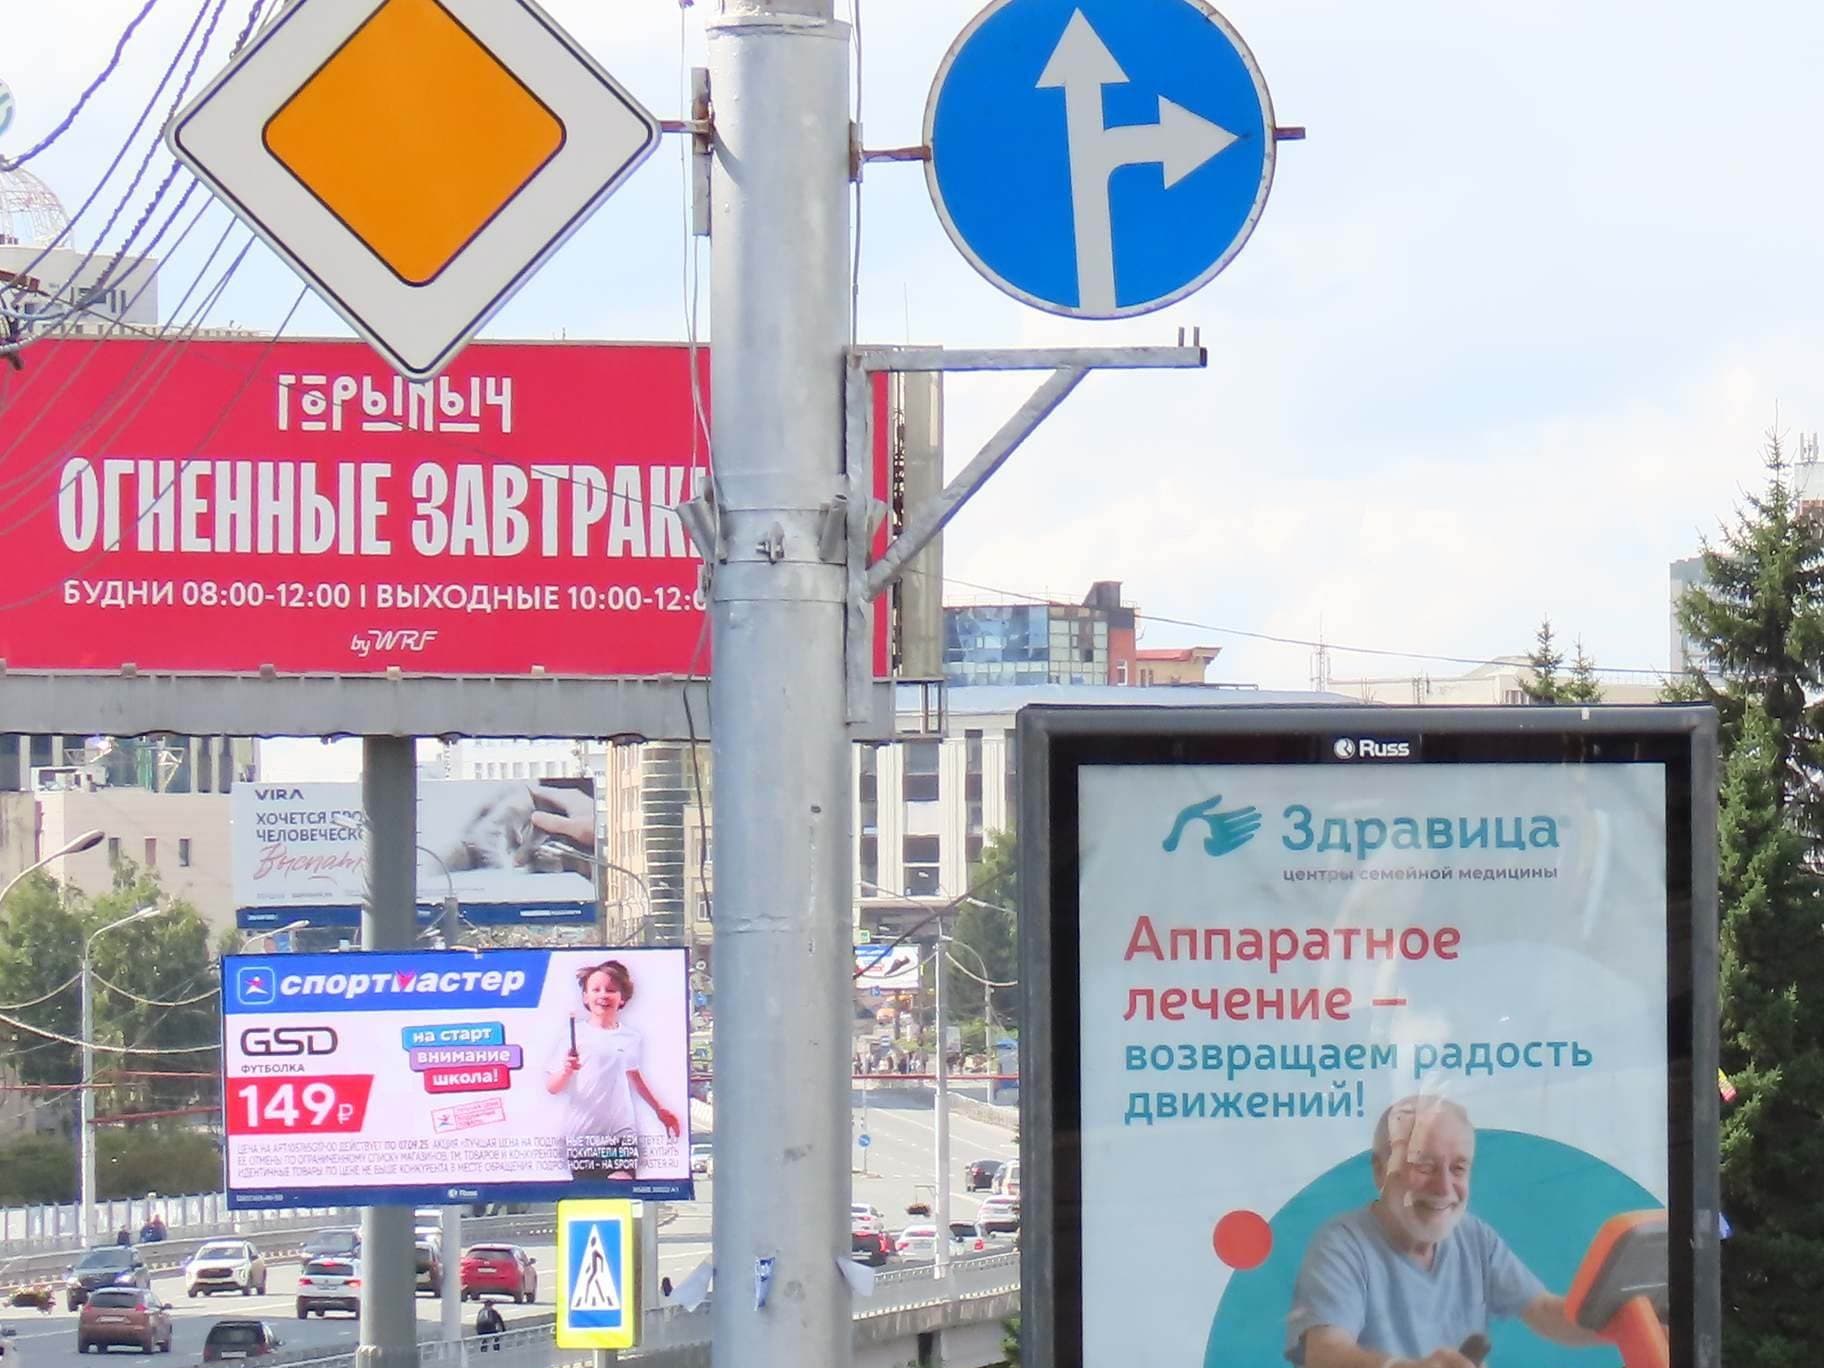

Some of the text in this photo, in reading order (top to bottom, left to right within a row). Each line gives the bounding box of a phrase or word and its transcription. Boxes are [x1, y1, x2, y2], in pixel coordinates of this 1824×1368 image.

[57, 456, 706, 560] ОГНЕННЫЕ ЗАВТРАК
[63, 579, 174, 608] БУДНИ
[182, 580, 351, 610] 08:00-12:00
[376, 582, 560, 613] ВЫХОДНЫЕ
[1359, 739, 1411, 758] Russ
[256, 811, 327, 825] ХОЧЕТСЯ
[1280, 803, 1561, 861] Здравица
[1282, 866, 1558, 883] центры семейной медицины
[1123, 914, 1462, 973] Аппаратное
[1123, 984, 1353, 1022] лечение
[240, 1026, 338, 1056] GSD
[413, 1027, 492, 1042] на старт
[240, 1063, 305, 1074] ФУТБОЛКА
[416, 1050, 510, 1063] внимание
[1123, 1039, 1593, 1080] возвращаем радость
[432, 1068, 499, 1086] школа!
[1123, 1080, 1366, 1125] движений!
